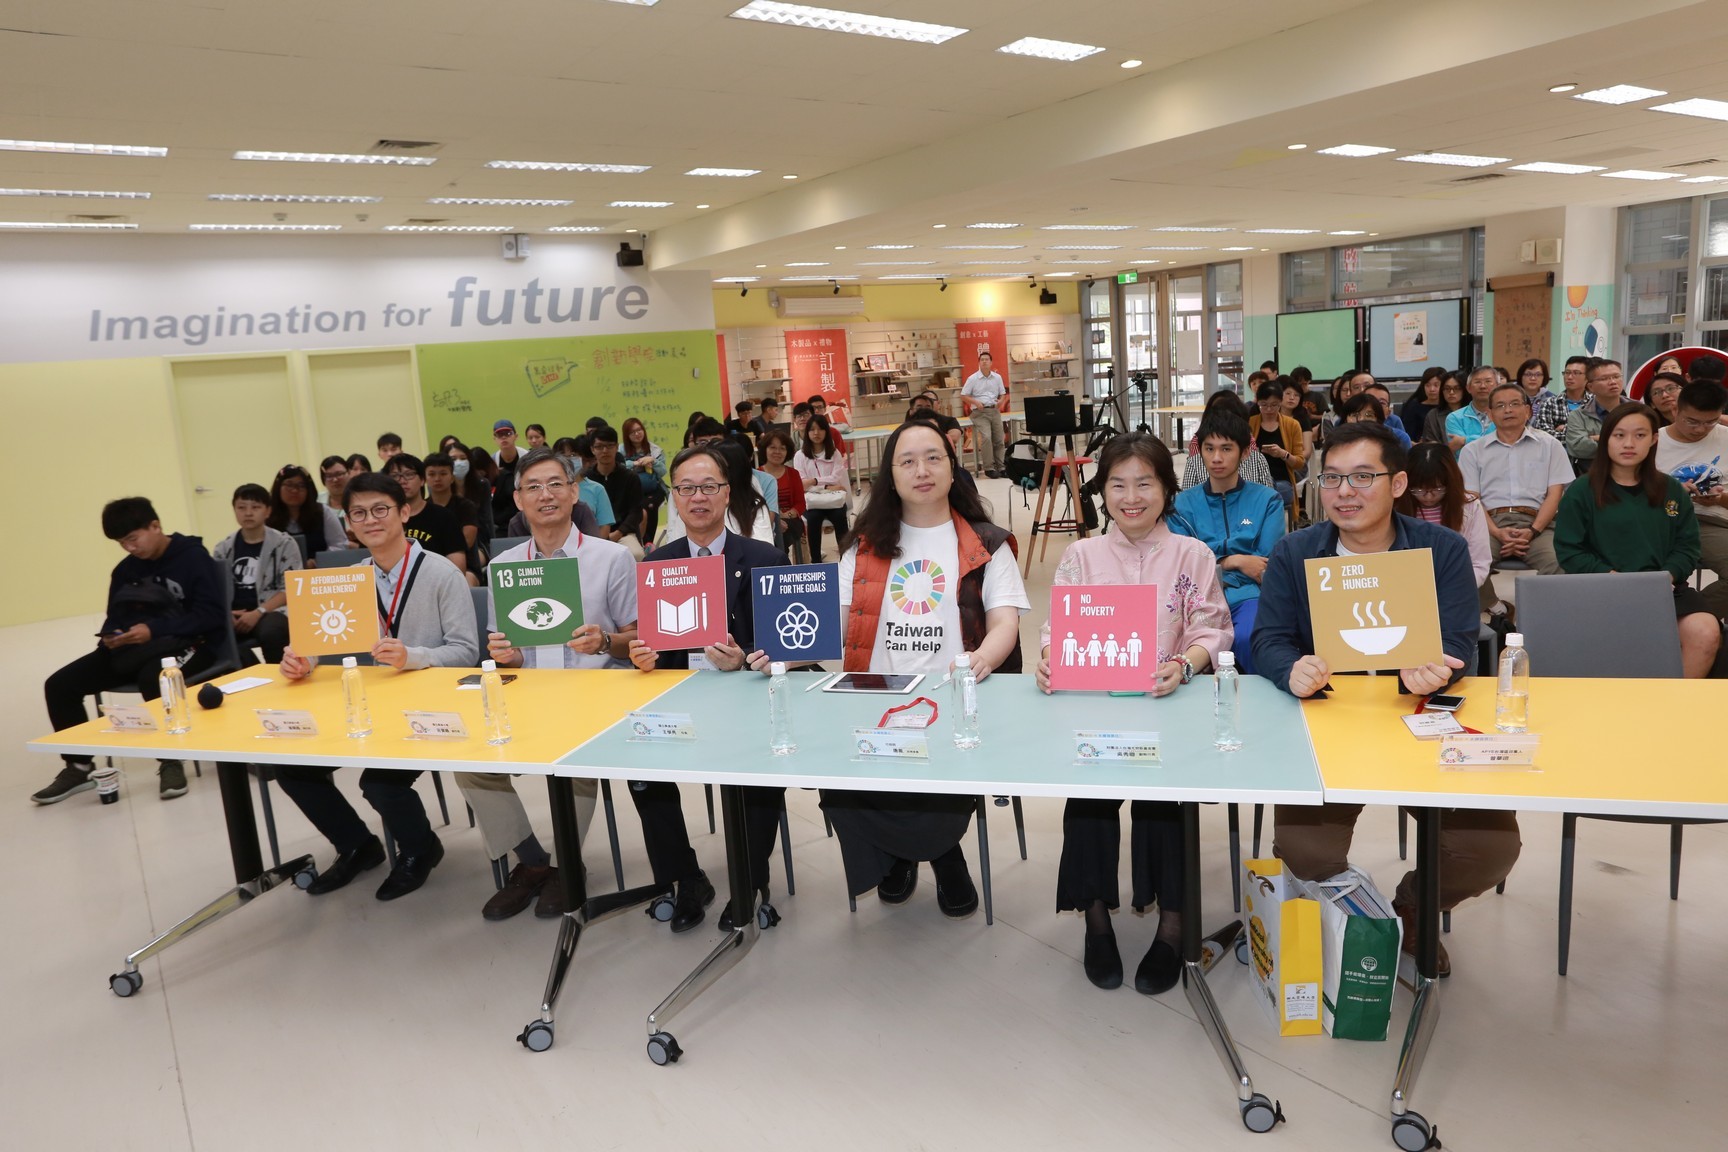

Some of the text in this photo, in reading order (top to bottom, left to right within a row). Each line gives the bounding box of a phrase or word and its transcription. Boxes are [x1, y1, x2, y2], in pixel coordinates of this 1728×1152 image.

[89, 276, 650, 346] Imagination for future
[791, 338, 812, 348] 木製品
[818, 352, 837, 393] 訂製
[517, 566, 544, 578] CLIMATE
[661, 566, 689, 577] QUALITY
[779, 571, 827, 583] PARTNERSHIPS
[1341, 564, 1365, 577] ZERO
[310, 573, 366, 585] AFFORDABLE AND
[496, 569, 514, 588] 13
[518, 577, 543, 588] ACTION
[645, 569, 656, 588] 4
[662, 576, 698, 587] EDUCATION
[759, 574, 774, 596] 17
[1318, 567, 1333, 592] 2
[1342, 577, 1379, 590] HUNGER
[294, 577, 304, 596] 7
[311, 584, 357, 595] CLEAN ENERGY
[779, 583, 827, 595] FOR THE GOALS
[1062, 594, 1071, 616] 1
[1080, 594, 1092, 604] NO
[1080, 606, 1115, 617] POVERTY
[886, 622, 943, 638] Taiwan
[885, 640, 942, 654] Can Help
